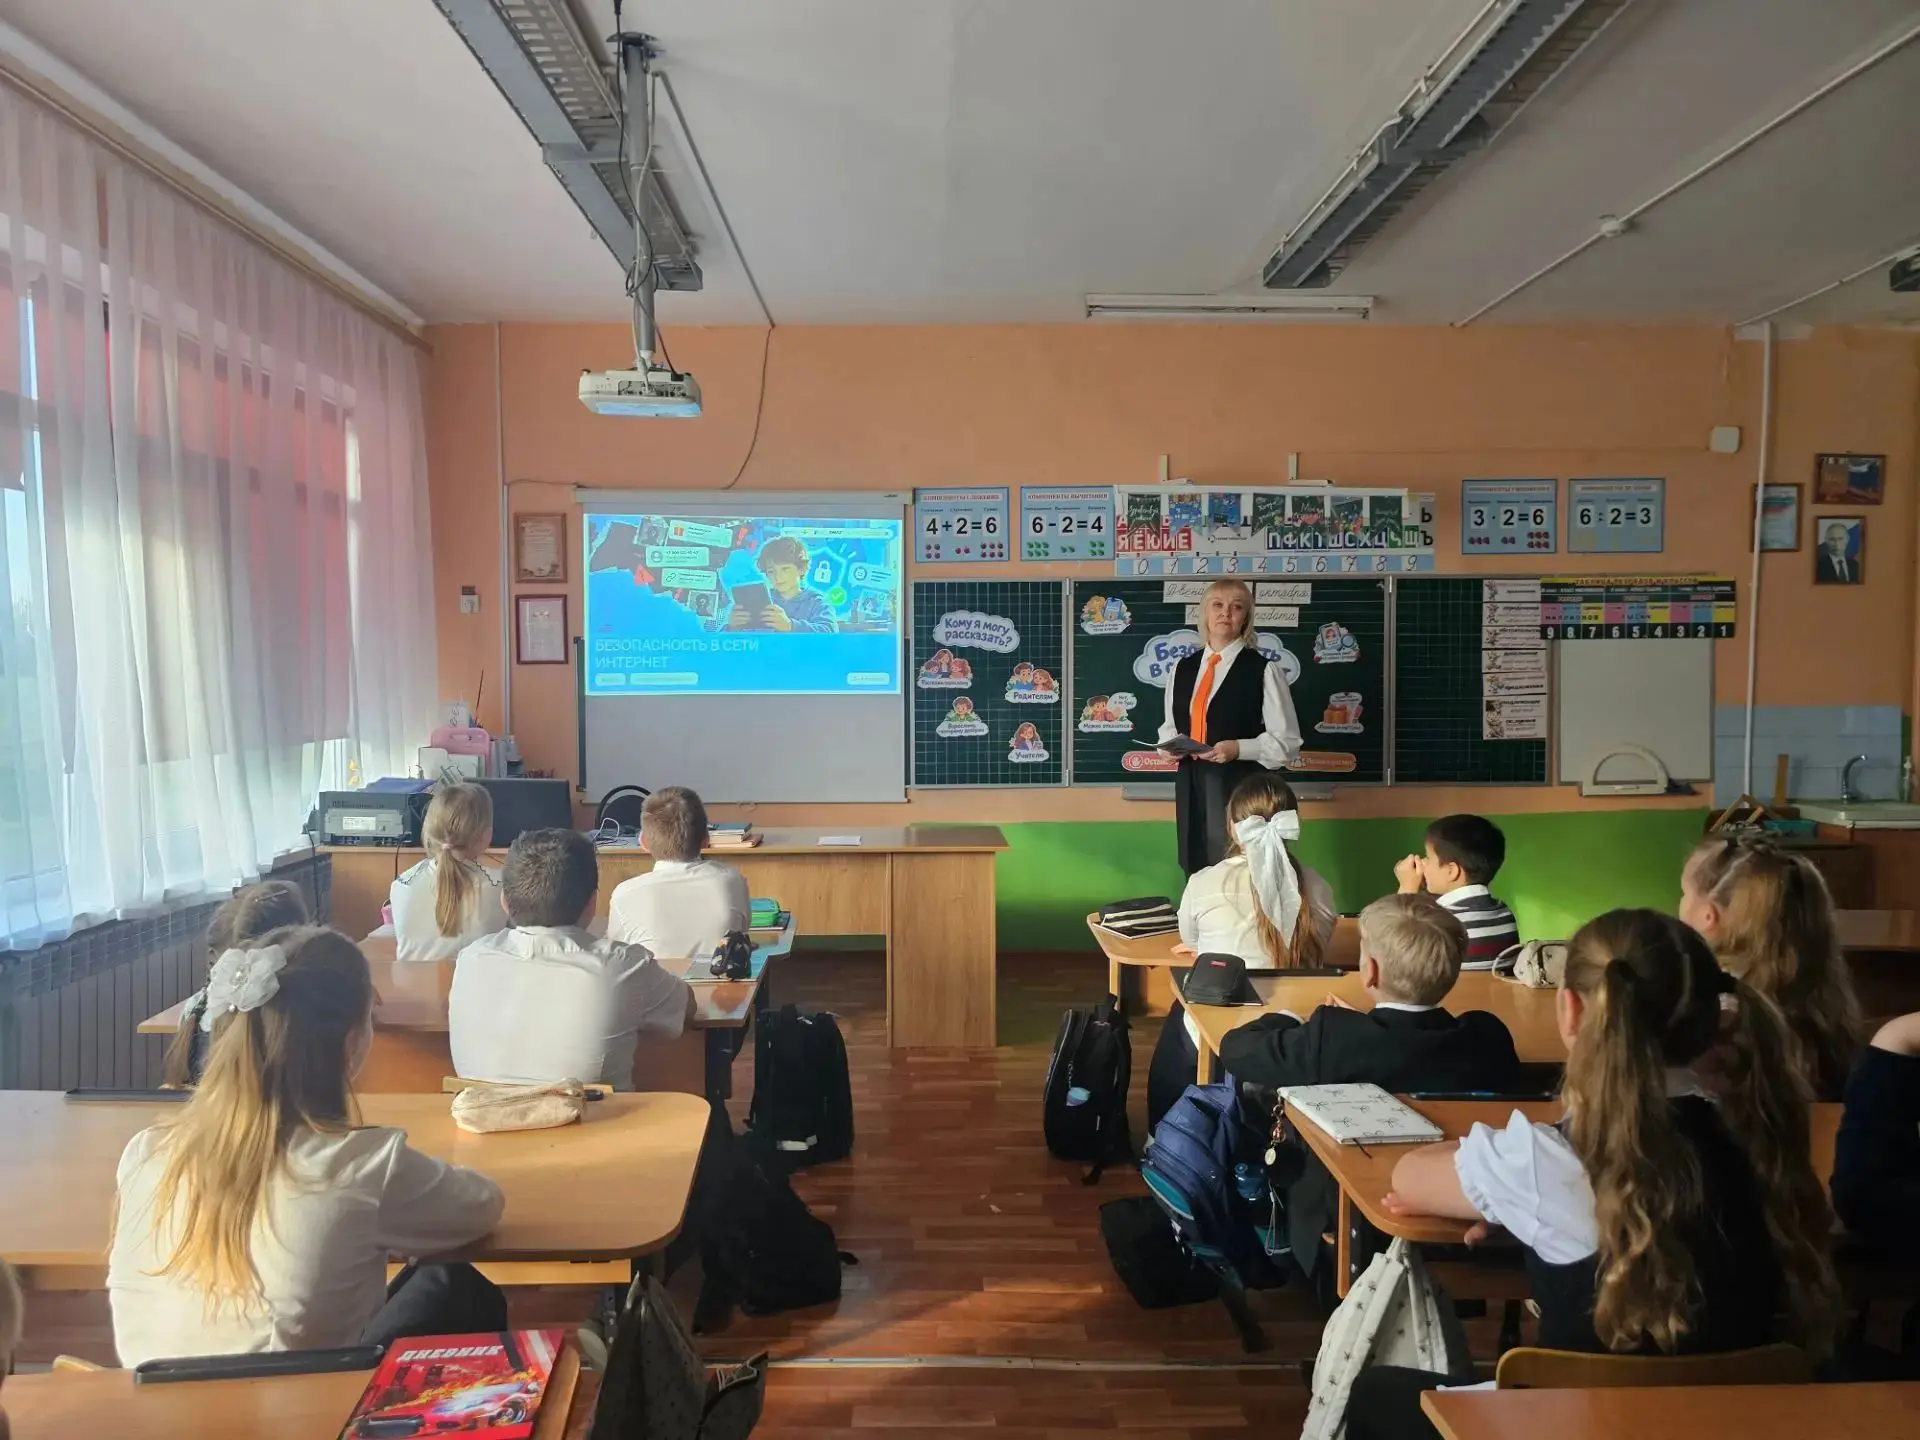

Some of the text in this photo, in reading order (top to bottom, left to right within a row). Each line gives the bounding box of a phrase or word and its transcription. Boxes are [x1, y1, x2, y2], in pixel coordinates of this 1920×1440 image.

[1138, 558, 1149, 575] 0
[1197, 557, 1209, 574] 2
[1226, 557, 1239, 574] 3
[1257, 557, 1268, 573] 4
[1286, 556, 1297, 572] 5
[1316, 556, 1328, 572] 6
[1346, 556, 1358, 572] 7
[1376, 556, 1387, 572] 8
[1407, 555, 1418, 572] 9
[945, 618, 972, 629] Кому
[983, 622, 1010, 636] могу
[1547, 625, 1727, 638] 9 8 7 6 5 4 3 2 1
[596, 638, 759, 651] БЕЗОПАСНОСТЬ В СЕТИ
[945, 630, 1012, 648] рассказать?
[596, 656, 668, 669] ИНТЕРНЕТ
[1014, 691, 1053, 700] Родителям
[1015, 752, 1045, 760] Учителю
[396, 1345, 504, 1363] ДНЕВНИК
